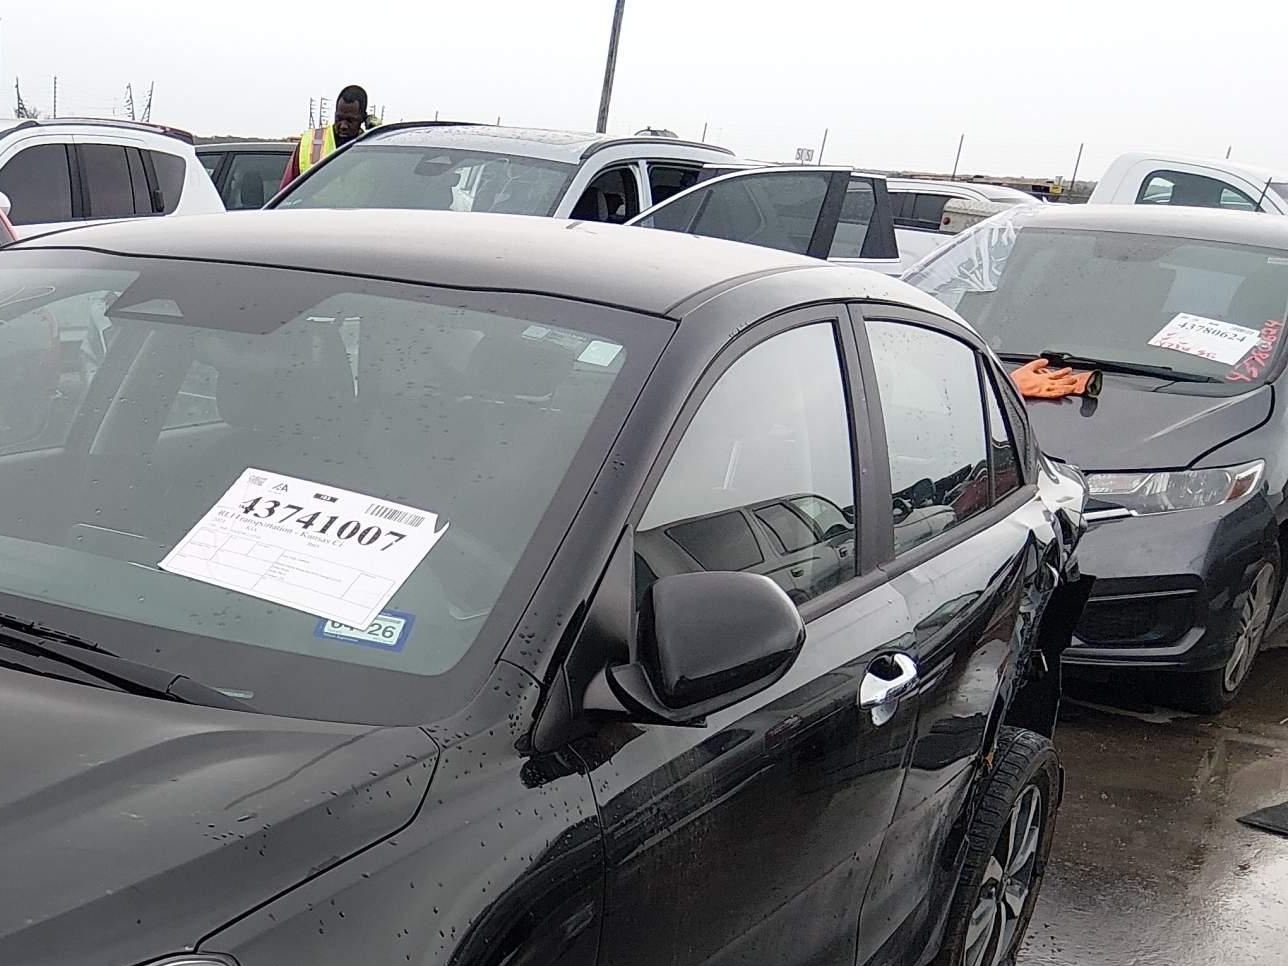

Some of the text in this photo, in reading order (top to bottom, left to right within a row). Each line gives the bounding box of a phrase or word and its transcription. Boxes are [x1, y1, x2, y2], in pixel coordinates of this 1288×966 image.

[1178, 322, 1247, 342] 43780624
[241, 496, 407, 551] 43741007
[367, 622, 396, 639] 26
